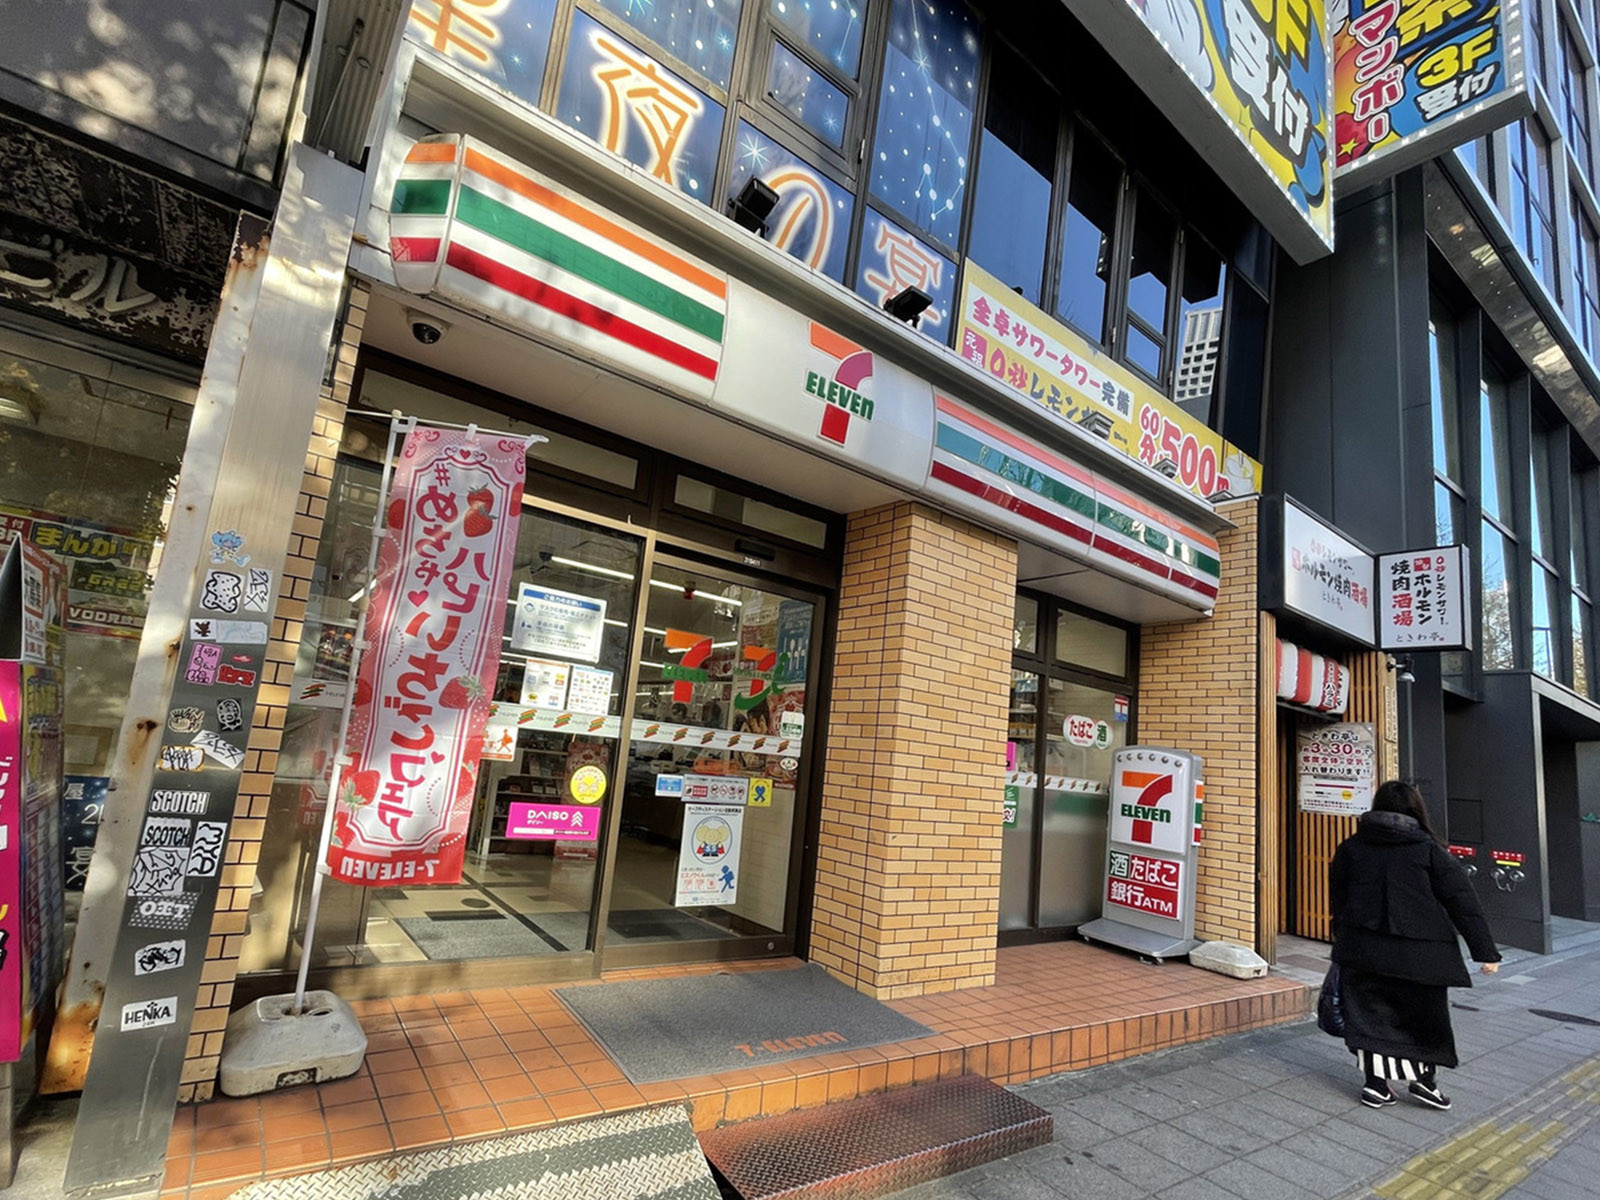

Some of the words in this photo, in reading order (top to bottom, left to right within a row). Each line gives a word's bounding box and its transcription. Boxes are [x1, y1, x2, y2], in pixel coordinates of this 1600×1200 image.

[1350, 1, 1404, 142] マンボー
[1417, 28, 1493, 87] 3F
[1417, 65, 1495, 120] 受付
[809, 321, 874, 445] 7
[972, 296, 1131, 416] 全卓サワータワー完備
[990, 348, 1127, 444] 0秒レモンー
[1390, 559, 1414, 627] 焼肉酒場
[1069, 719, 1093, 739] たばこ
[1097, 723, 1108, 743] 酒
[151, 790, 208, 815] SCOTCH
[527, 810, 569, 821] DAISO
[1122, 770, 1173, 844] 7
[145, 825, 191, 846] SCOTCH
[1109, 853, 1129, 878] 酒
[1130, 857, 1177, 887] たばこ
[1110, 881, 1174, 914] 銀行ATM
[125, 1004, 172, 1025] HENKA
